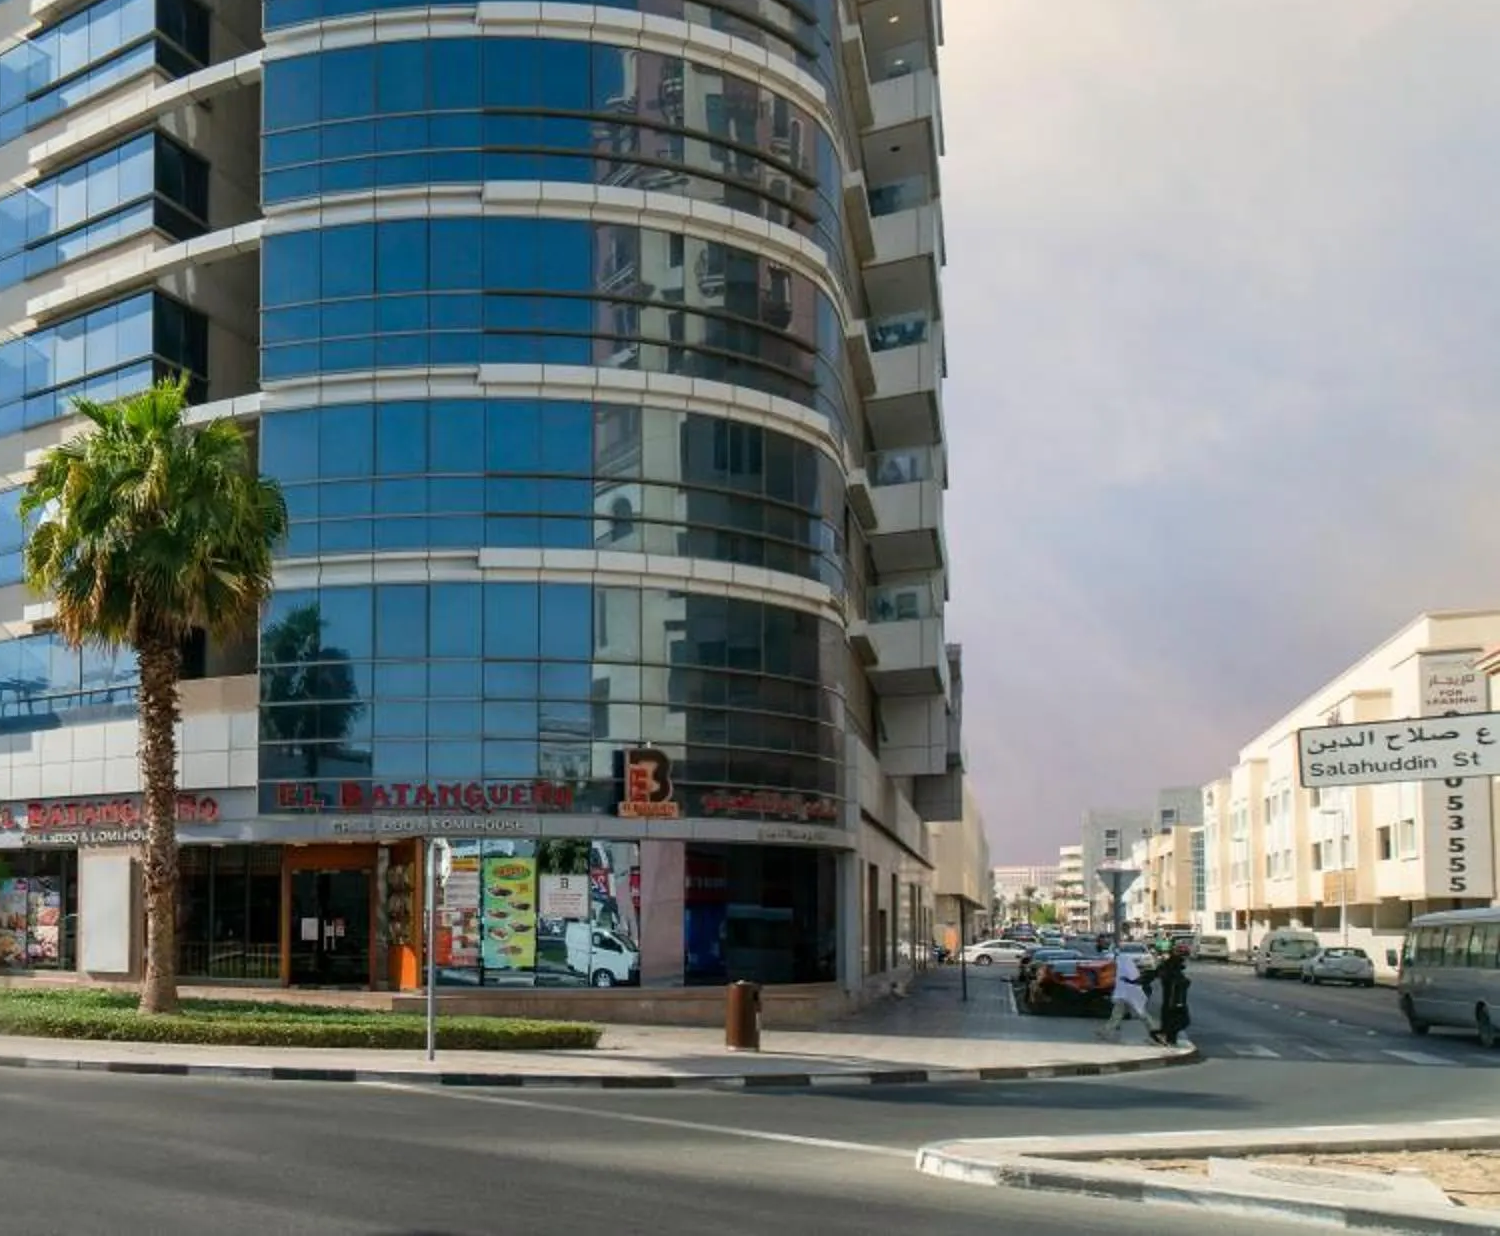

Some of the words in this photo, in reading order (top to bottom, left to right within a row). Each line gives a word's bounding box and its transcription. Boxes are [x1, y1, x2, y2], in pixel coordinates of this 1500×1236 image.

[1307, 730, 1375, 755] الدين
[1385, 727, 1461, 751] صلاح
[1310, 755, 1438, 778] Salahuddin
[1452, 751, 1482, 768] St
[278, 781, 324, 807] EL
